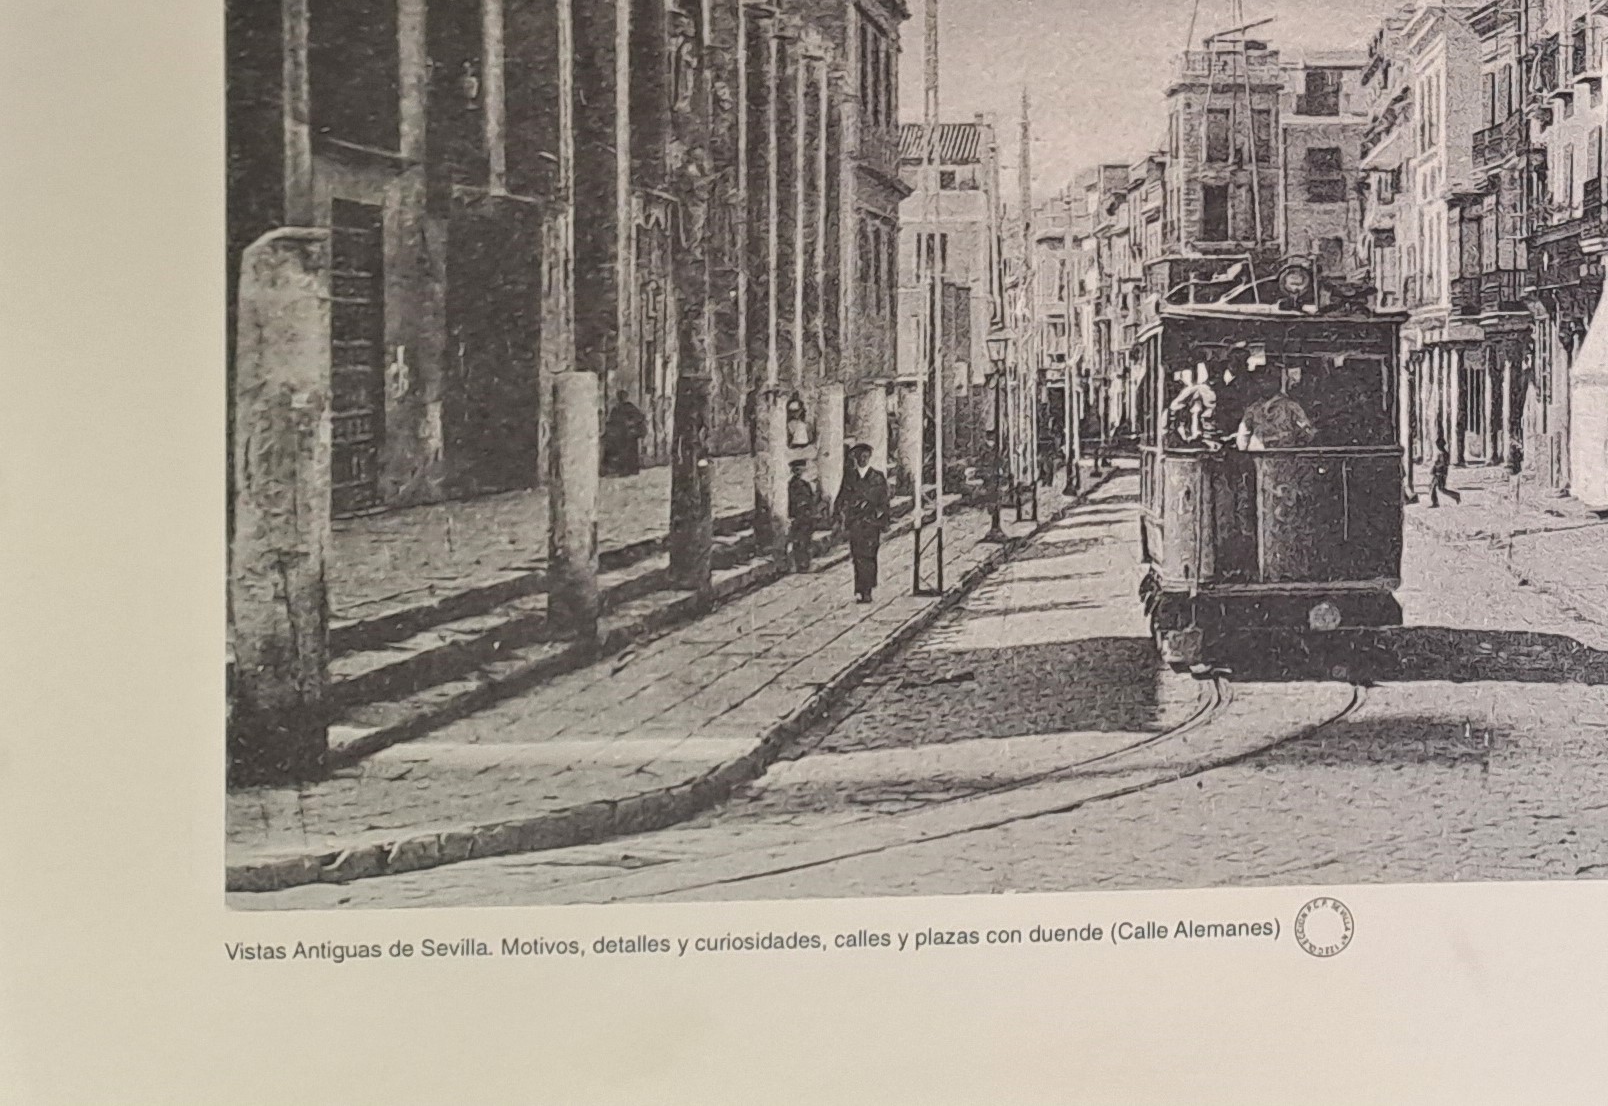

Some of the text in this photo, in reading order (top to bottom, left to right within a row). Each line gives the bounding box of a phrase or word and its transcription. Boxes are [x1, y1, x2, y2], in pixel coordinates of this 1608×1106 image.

[224, 917, 1281, 964] Vistas Antiguas de Sevilla. Motivos, detalles y curiosidades, calles y plazas con duende (Calle Alemanes)
